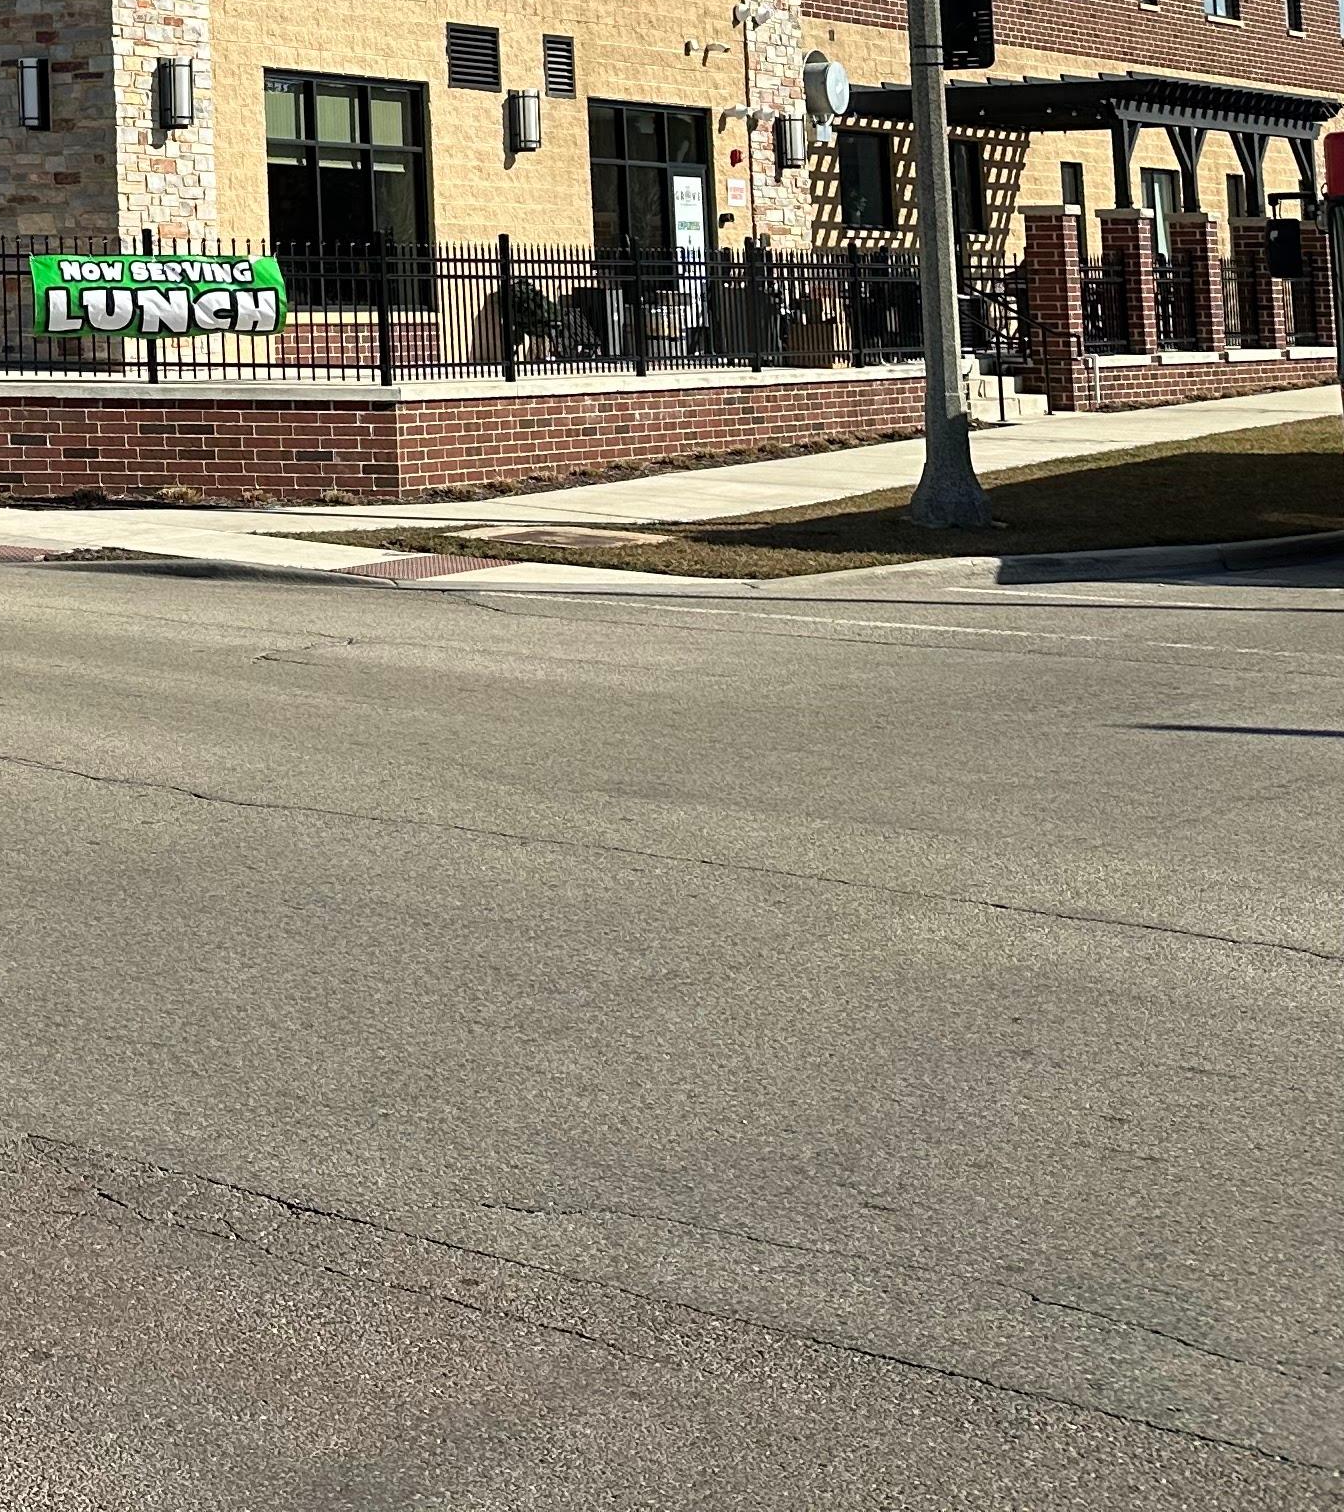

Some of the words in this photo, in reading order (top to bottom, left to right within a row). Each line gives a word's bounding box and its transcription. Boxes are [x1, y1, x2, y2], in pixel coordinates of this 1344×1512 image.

[60, 260, 123, 281] NOW
[130, 261, 253, 282] SERVING
[47, 288, 277, 332] LUNCH
